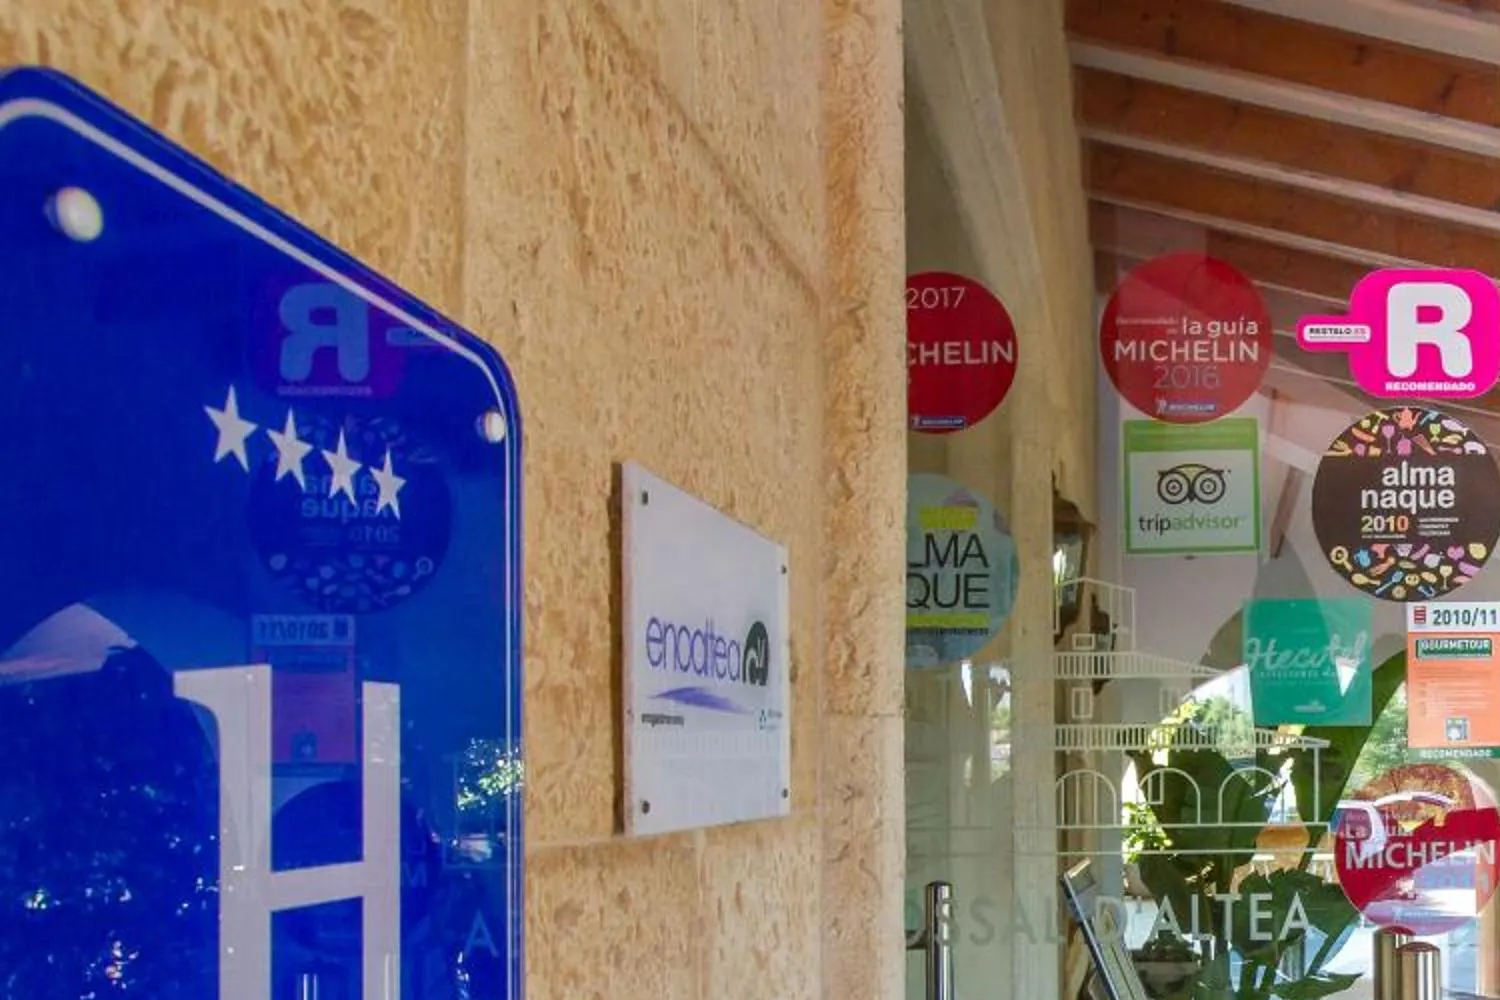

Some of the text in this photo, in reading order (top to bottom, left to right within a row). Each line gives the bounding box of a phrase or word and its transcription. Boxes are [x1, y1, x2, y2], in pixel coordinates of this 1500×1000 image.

[906, 287, 965, 309] 2017
[1183, 316, 1202, 335] la
[1207, 316, 1259, 338] guía
[1387, 282, 1473, 378] R
[1114, 340, 1259, 363] MICHELIN
[1153, 365, 1221, 389] 2016
[1385, 381, 1476, 391] RECOMENDADO
[1382, 460, 1455, 486] alma
[1361, 488, 1455, 515] naque
[1138, 513, 1240, 536] tripadvisor
[1361, 515, 1409, 533] 2010
[1432, 608, 1497, 626] 2010/11
[1345, 840, 1496, 870] MICHELIN
